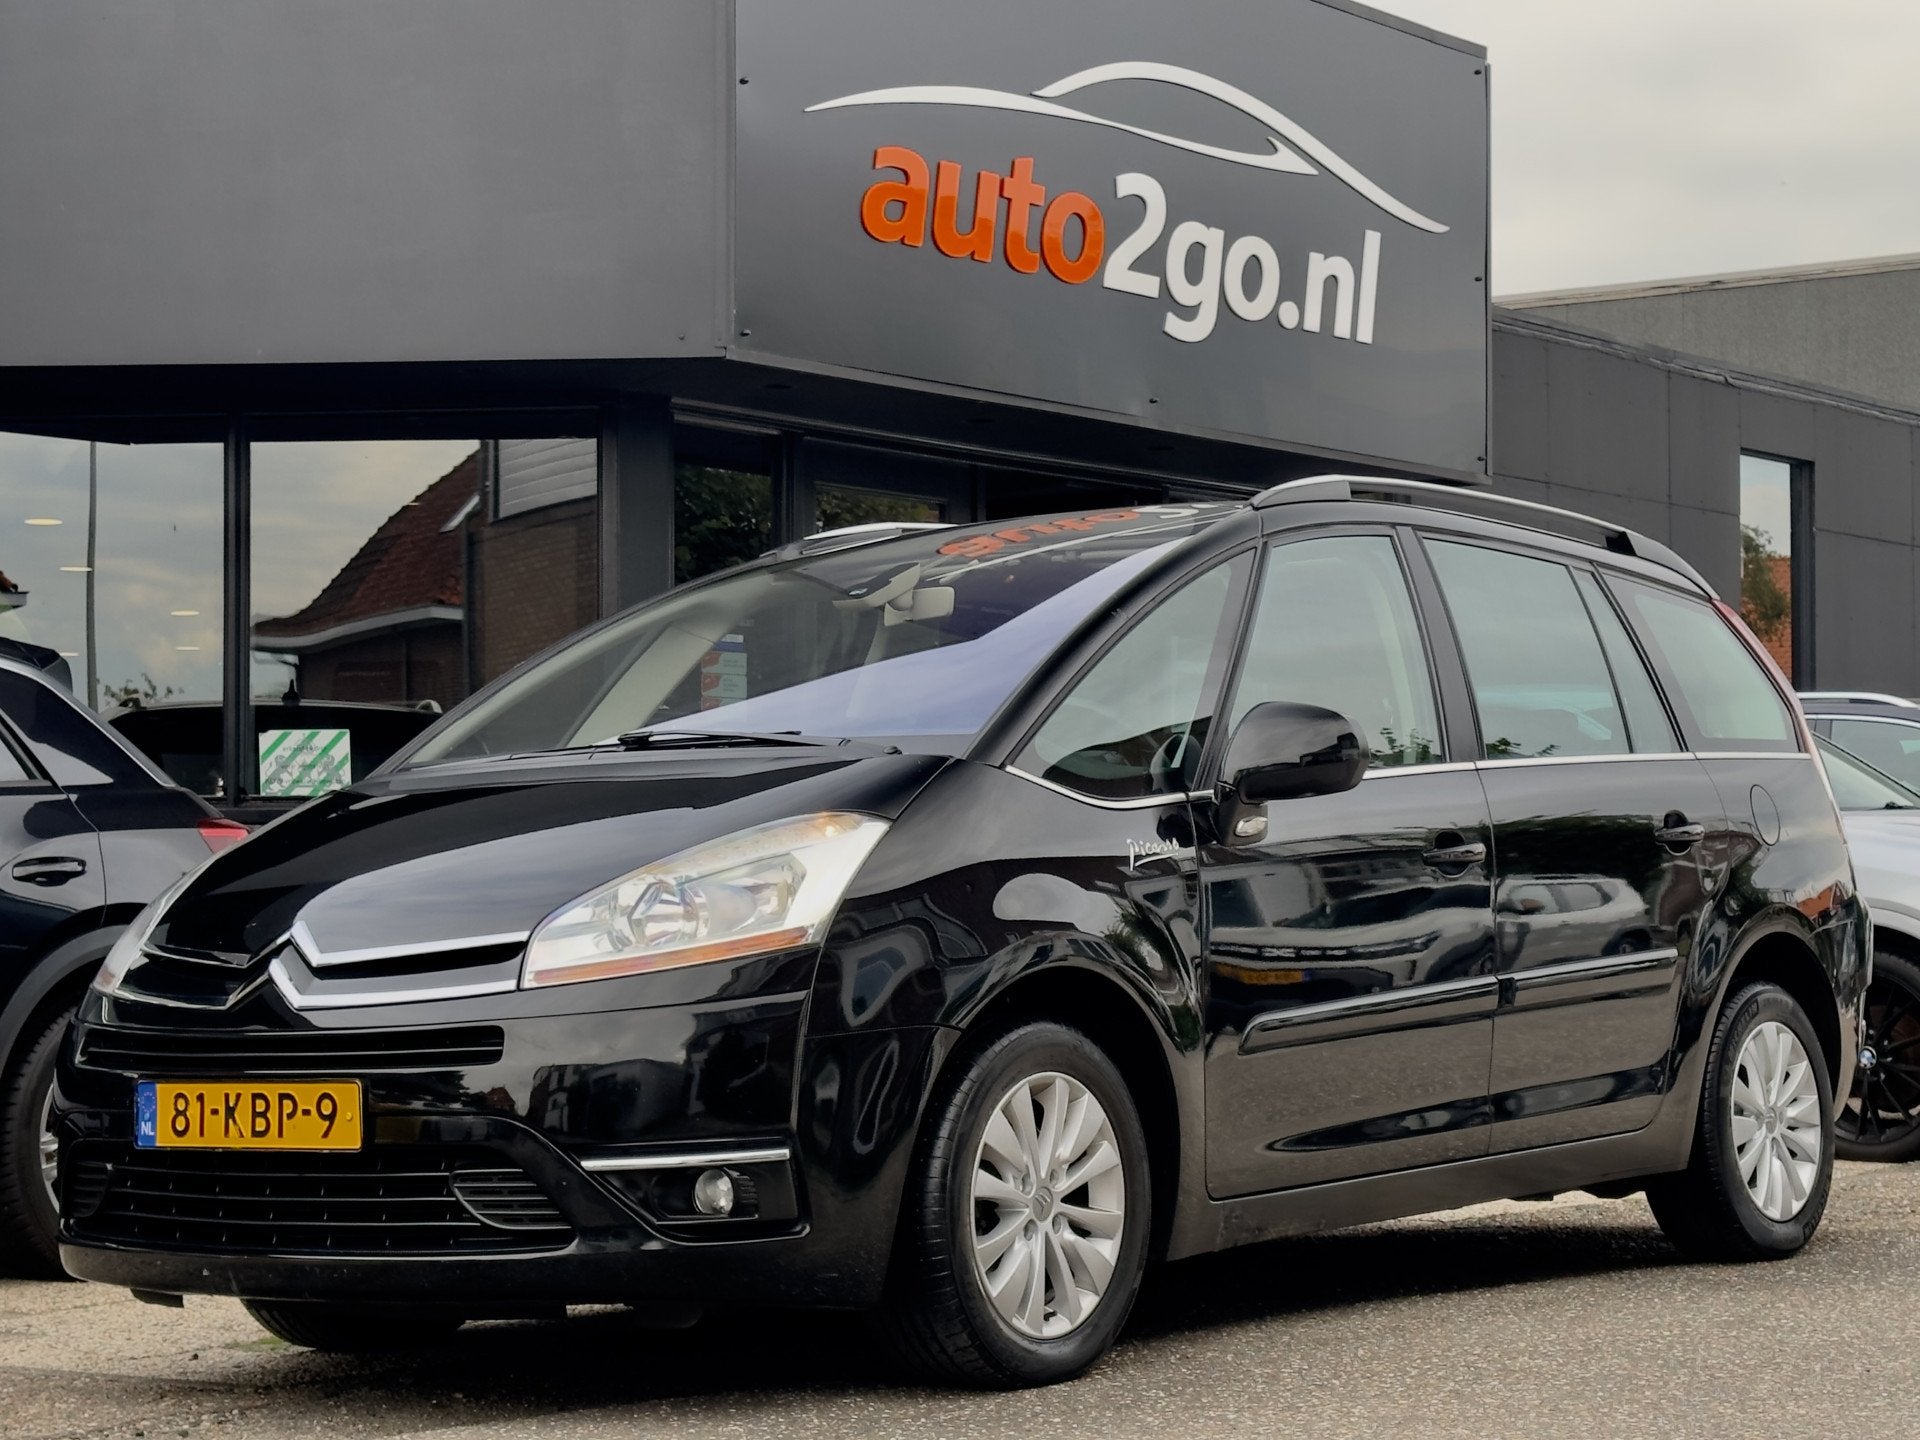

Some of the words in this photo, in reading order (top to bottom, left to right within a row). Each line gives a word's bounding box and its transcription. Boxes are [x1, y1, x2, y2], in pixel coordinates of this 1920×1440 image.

[861, 146, 1381, 344] auto2go.nl
[140, 1121, 155, 1136] NL
[170, 1092, 338, 1139] 81-KBP-9
